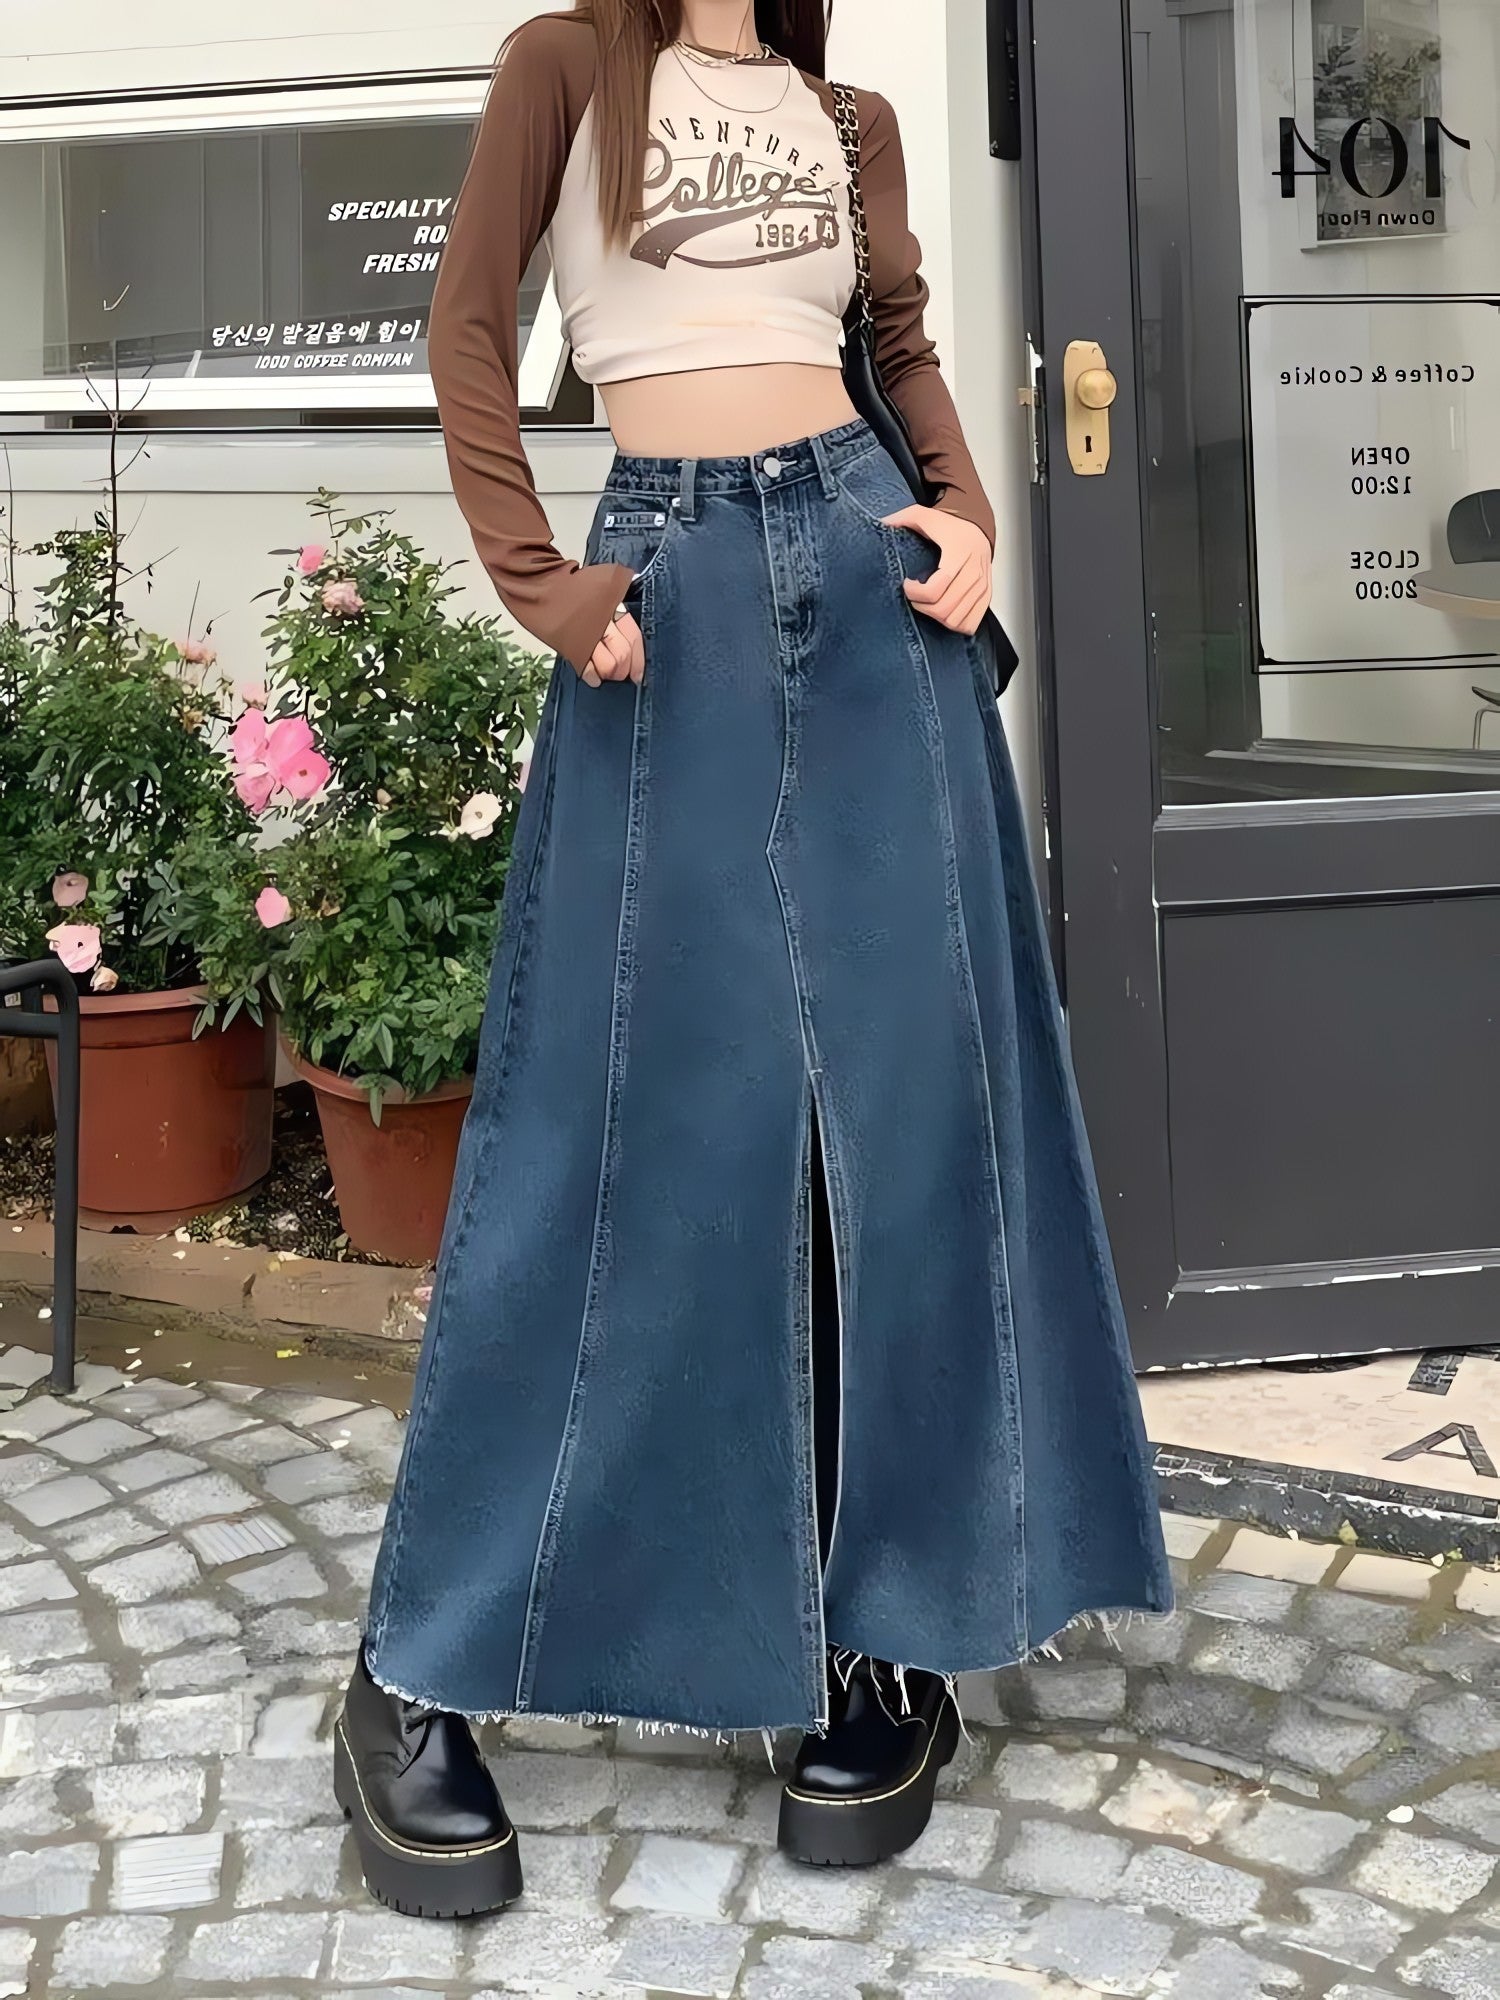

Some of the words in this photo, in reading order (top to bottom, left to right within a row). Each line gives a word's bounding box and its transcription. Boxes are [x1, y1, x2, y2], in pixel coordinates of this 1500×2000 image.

[328, 197, 452, 221] SPECIALTY
[413, 225, 449, 245] RO
[363, 252, 440, 274] FRESH
[212, 324, 275, 347] 당신의
[294, 354, 348, 369] COFFEE
